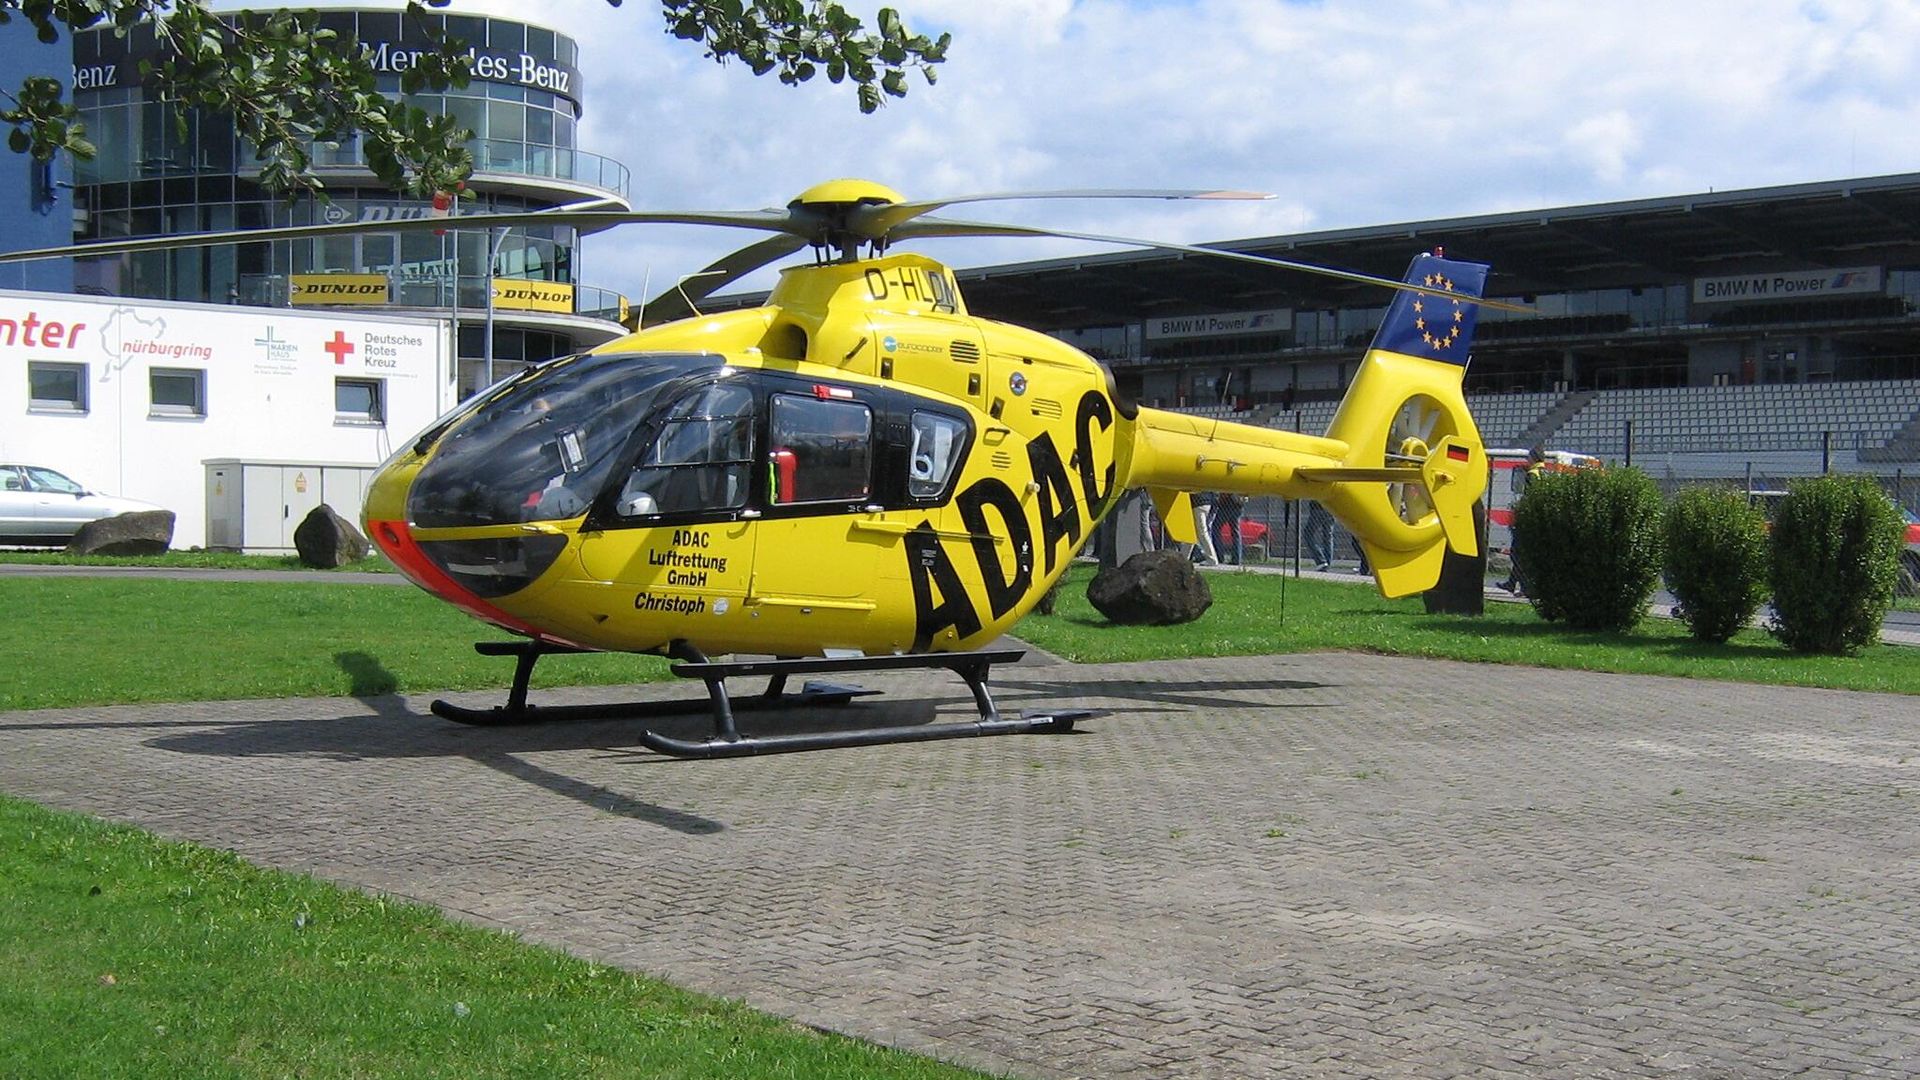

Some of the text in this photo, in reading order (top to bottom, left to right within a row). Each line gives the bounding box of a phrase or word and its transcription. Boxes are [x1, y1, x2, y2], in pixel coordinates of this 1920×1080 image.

[360, 42, 570, 93] Meres-Benz
[305, 284, 386, 295] DUNLOP
[1705, 277, 1826, 297] BMW M Power
[504, 289, 572, 303] DUNLOP
[1161, 317, 1246, 334] BMW M Power
[270, 344, 299, 352] MARIEN
[364, 332, 423, 347] Deutsches
[122, 340, 212, 360] nürburgring
[364, 345, 397, 356] Rotes
[364, 357, 397, 368] Kreuz
[903, 390, 1116, 654] ADAC
[672, 530, 710, 548] ADAC
[649, 548, 728, 573] Luftrettung
[668, 570, 707, 587] GmbH
[634, 592, 706, 615] Christoph
